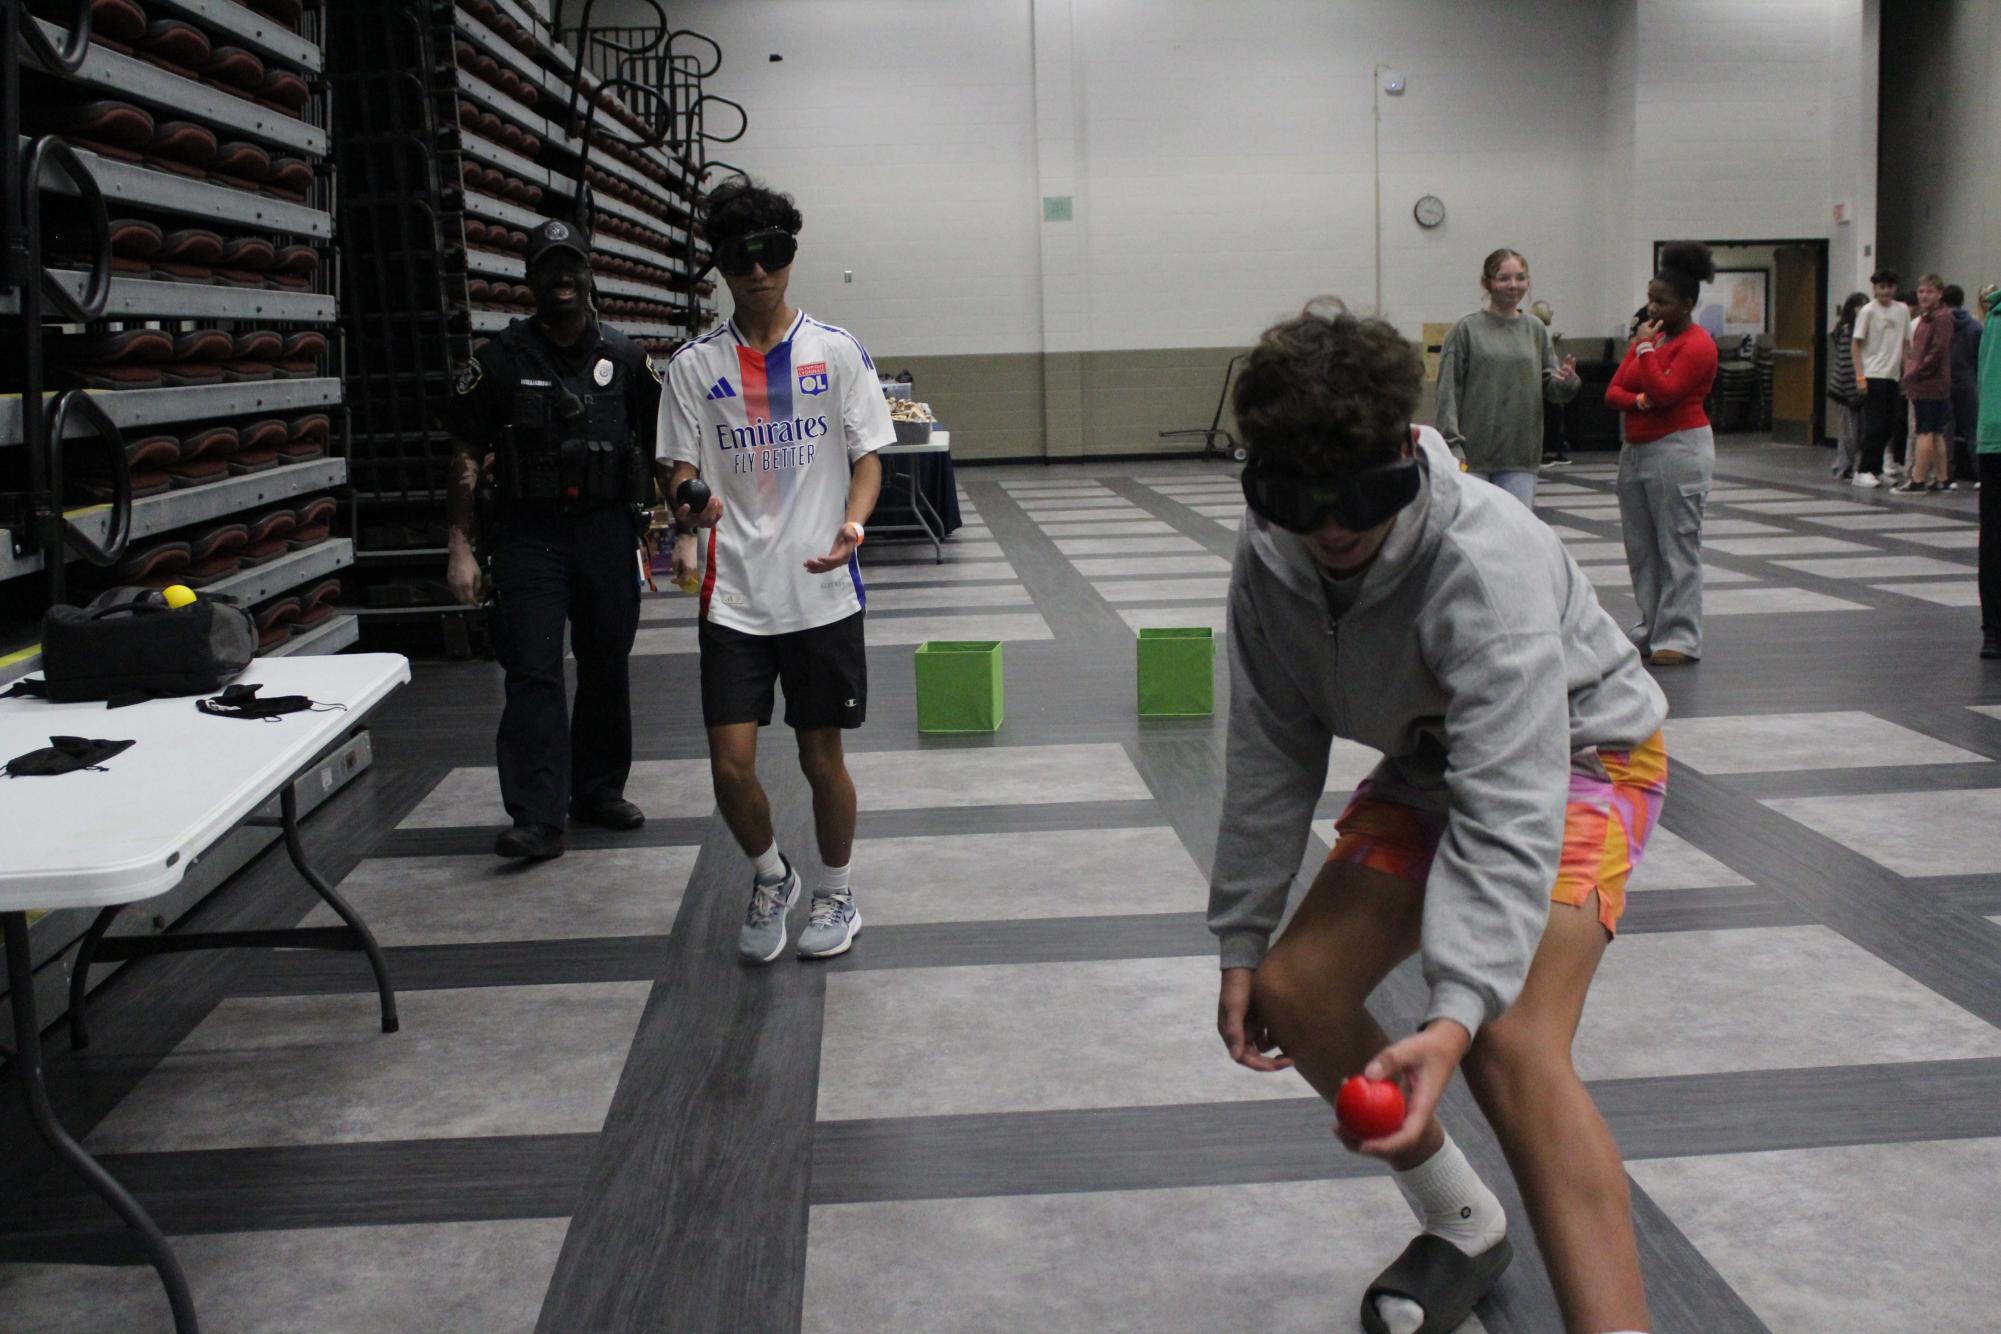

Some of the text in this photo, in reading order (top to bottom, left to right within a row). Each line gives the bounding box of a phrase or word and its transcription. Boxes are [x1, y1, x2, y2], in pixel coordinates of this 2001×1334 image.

[801, 375, 826, 391] OL
[716, 415, 828, 450] Emirates
[735, 445, 815, 473] FLY BETTER
